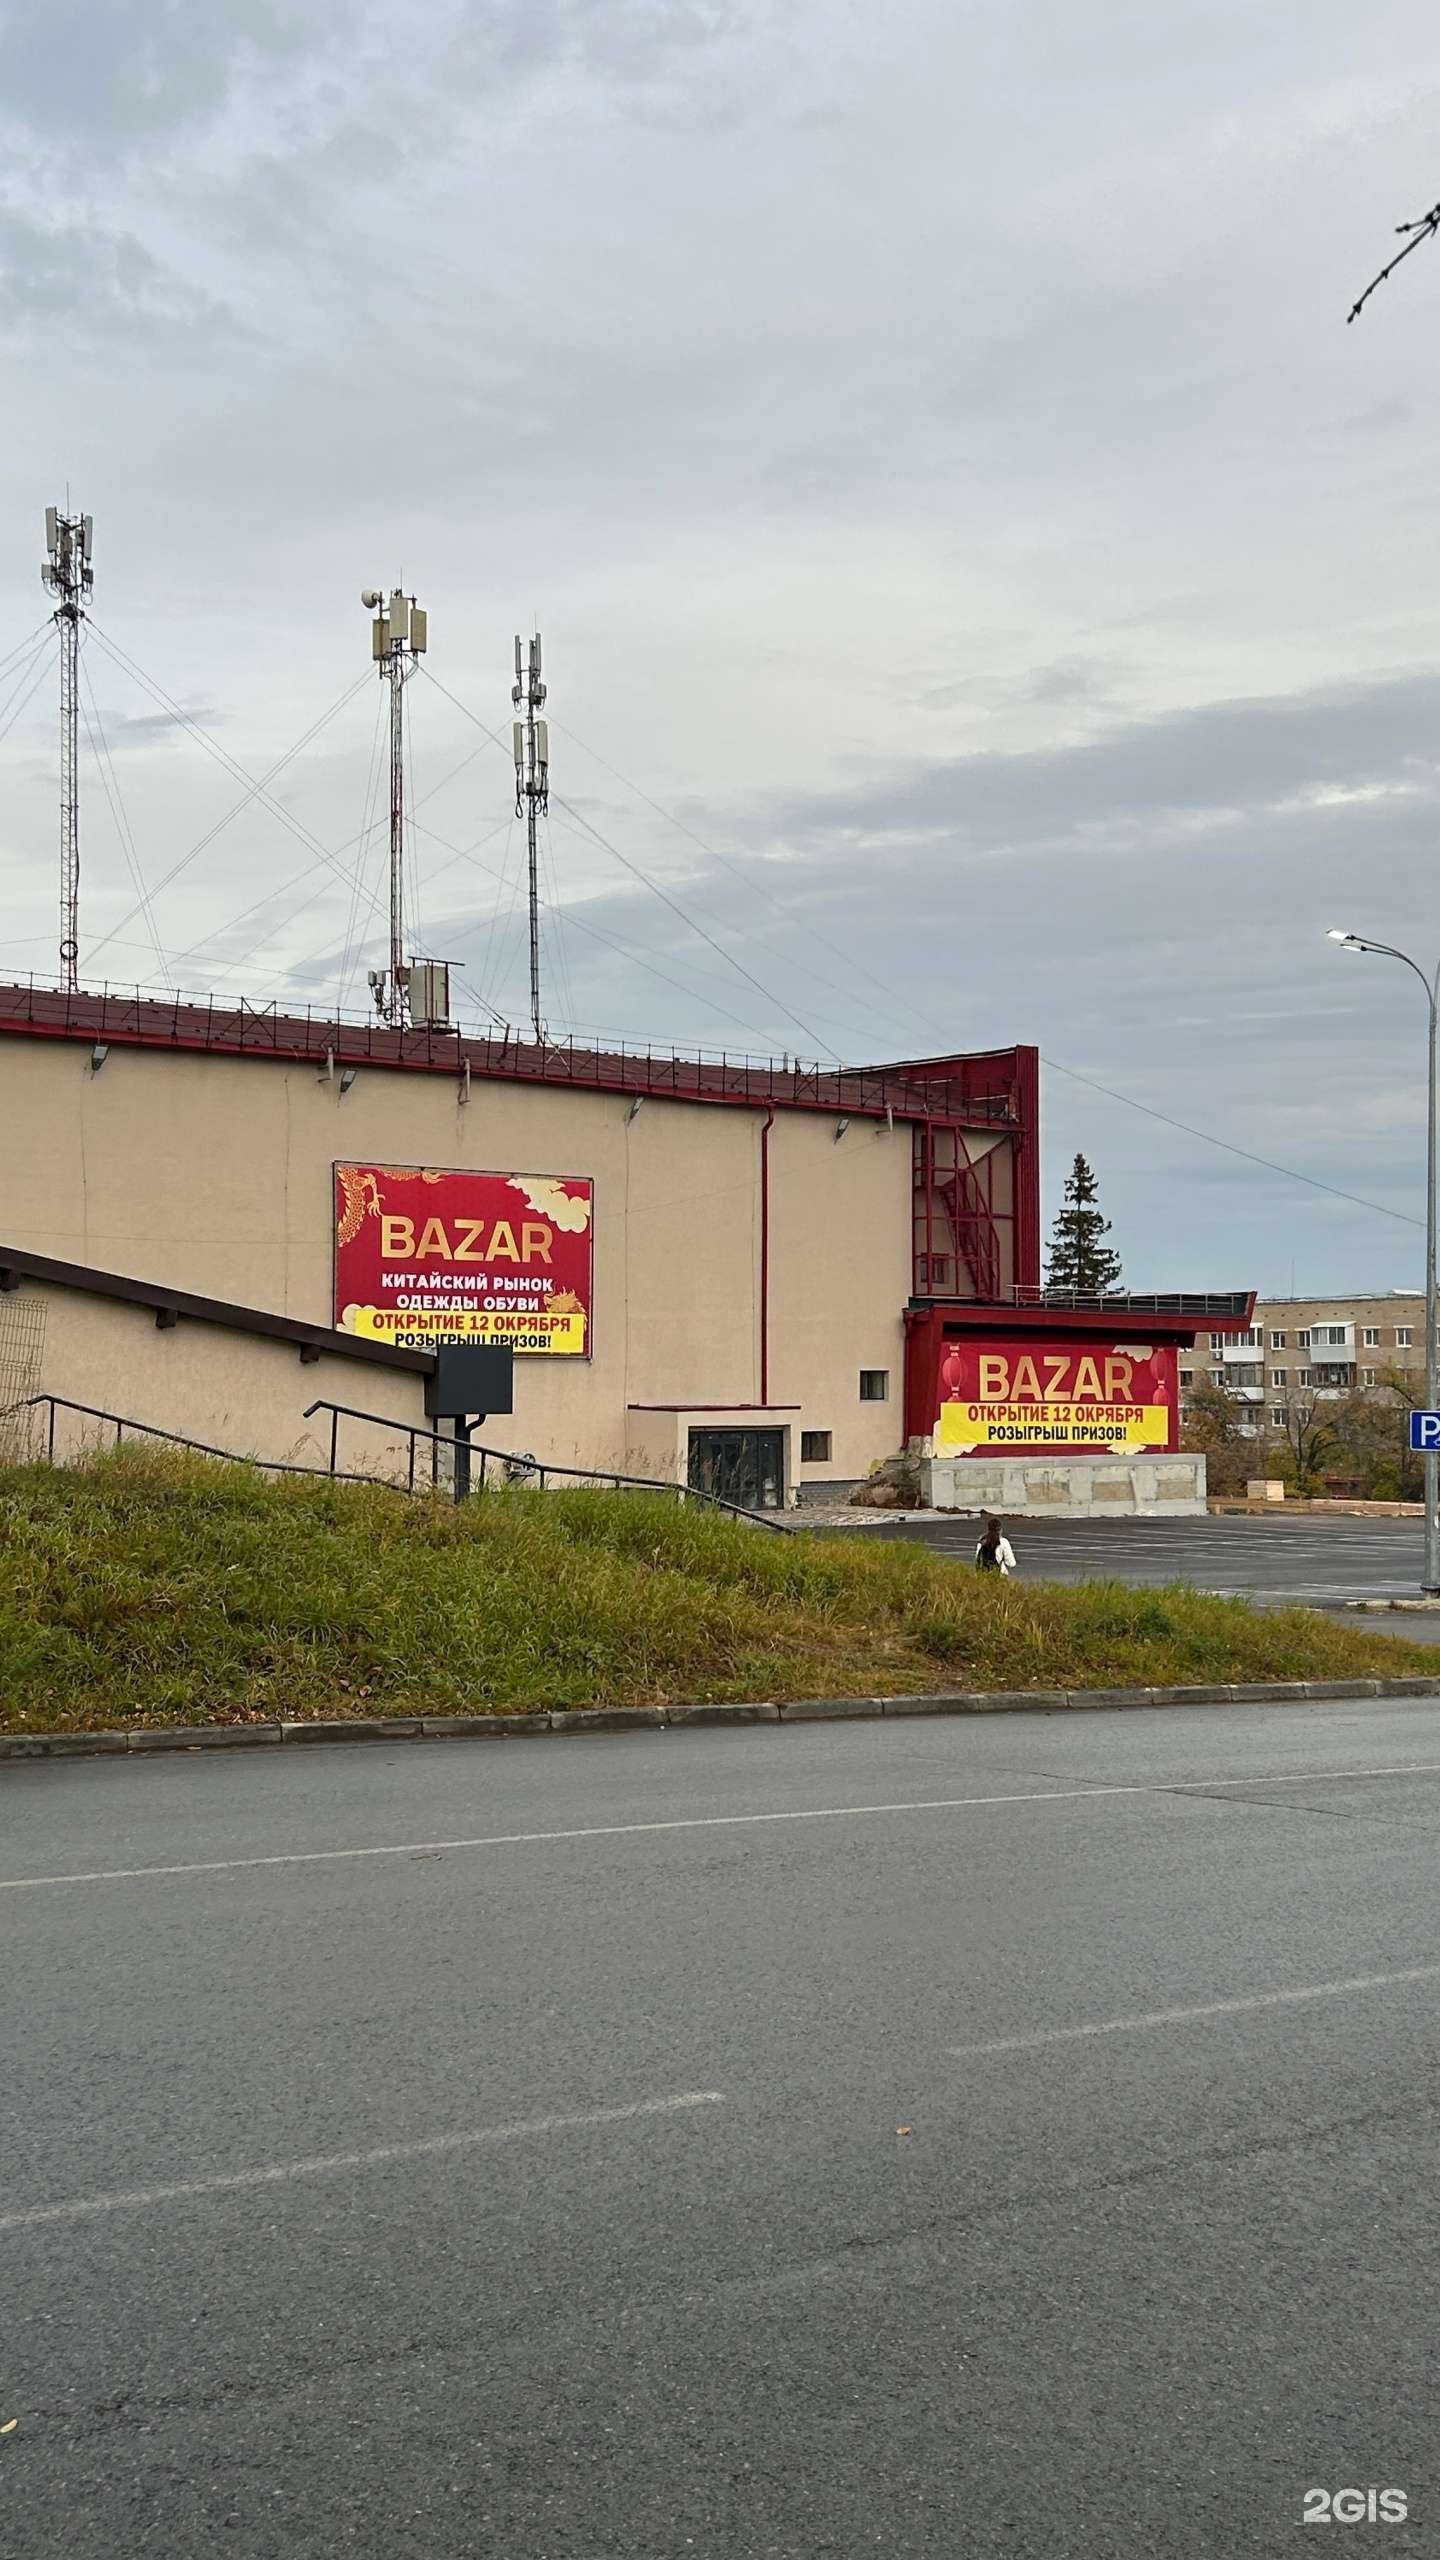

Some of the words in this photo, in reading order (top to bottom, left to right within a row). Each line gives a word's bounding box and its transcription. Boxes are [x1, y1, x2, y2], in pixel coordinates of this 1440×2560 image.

[381, 1214, 553, 1264] BAZAR
[381, 1271, 488, 1291] КИТАЙСКИЙ
[493, 1276, 553, 1292] РЫНОК
[396, 1294, 478, 1312] ОДЕЖДЫ
[483, 1296, 539, 1311] ОБУВИ
[372, 1313, 465, 1330] ОТКРЫТИЕ
[469, 1315, 489, 1331] 12
[493, 1316, 571, 1332] ОКРЯБРЯ
[395, 1332, 486, 1347] РОЗЫГРЫШ
[490, 1334, 552, 1348] ПРИЗОВ!
[979, 1354, 1134, 1401] BAZAR
[968, 1405, 1049, 1422] ОТКРЫТИЕ
[1053, 1406, 1071, 1422] 12
[1075, 1406, 1144, 1424] ОКРЯБРЯ
[988, 1425, 1068, 1441] РОЗЫГРЫШ
[1072, 1426, 1127, 1441] ПРИЗОВ!
[1421, 1415, 1440, 1446] P
